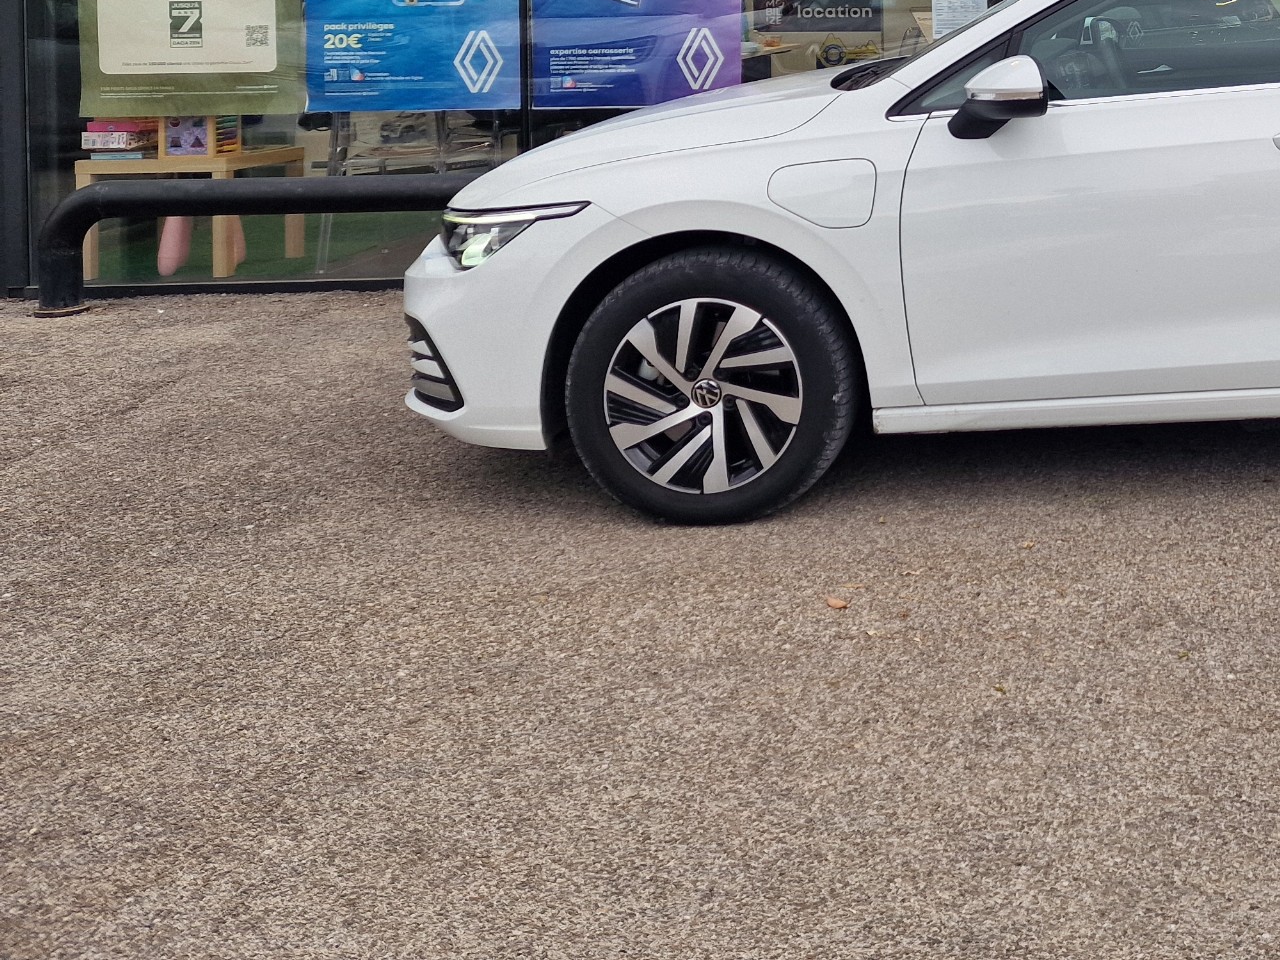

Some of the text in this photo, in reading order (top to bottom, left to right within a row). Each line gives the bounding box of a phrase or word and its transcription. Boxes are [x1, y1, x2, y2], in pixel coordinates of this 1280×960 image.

[797, 5, 873, 18] location
[172, 10, 200, 32] 7
[324, 23, 347, 31] pack
[550, 48, 587, 56] expertise
